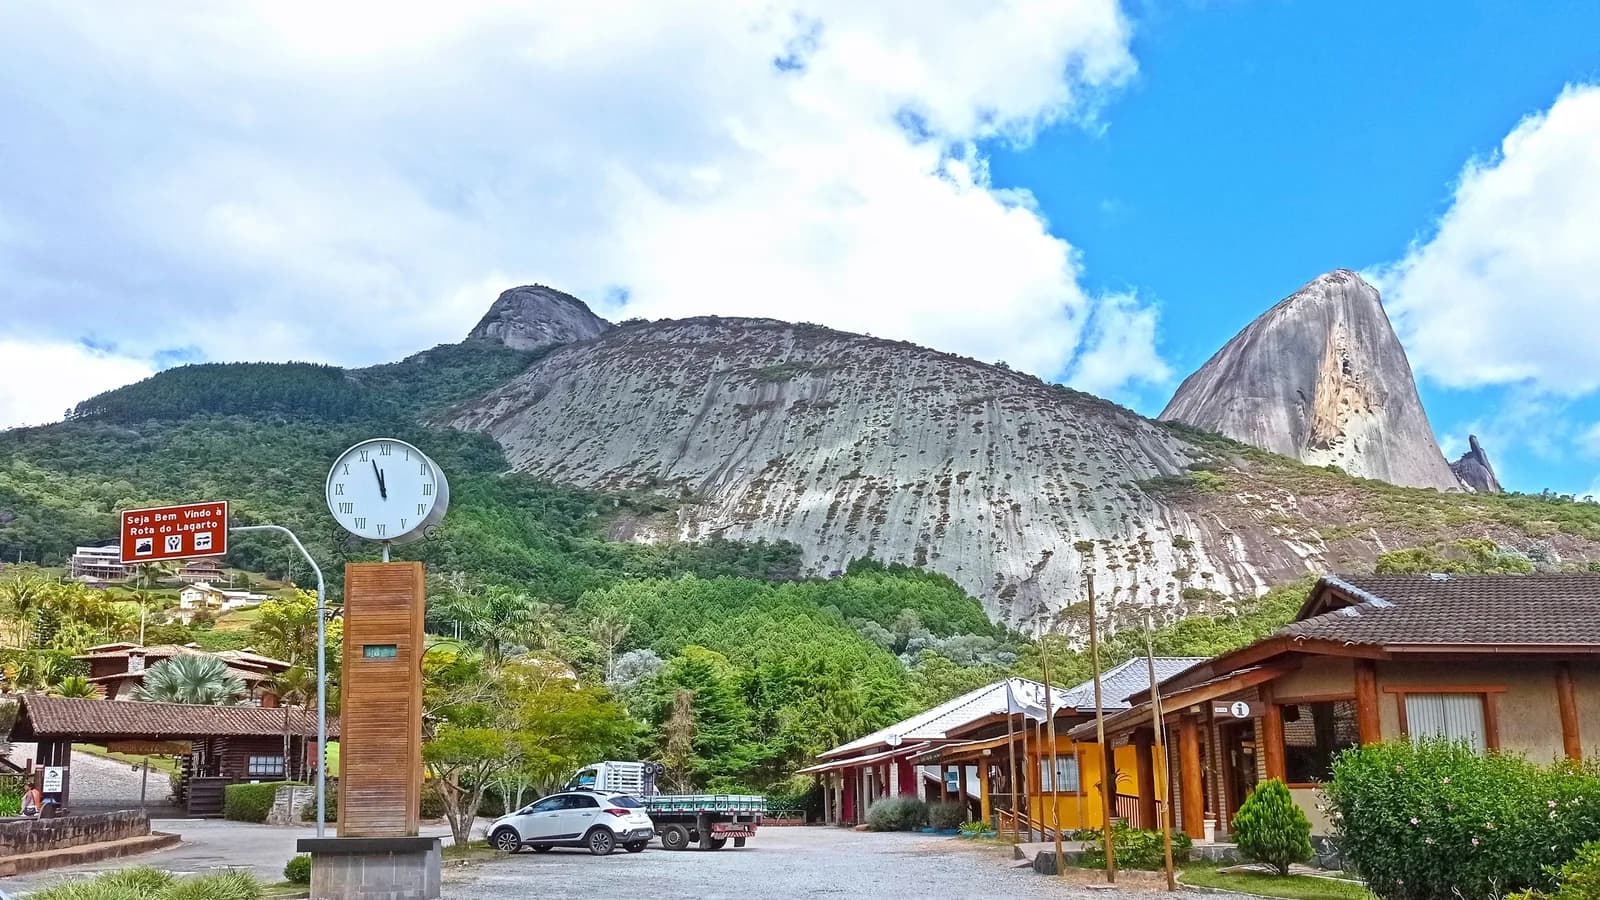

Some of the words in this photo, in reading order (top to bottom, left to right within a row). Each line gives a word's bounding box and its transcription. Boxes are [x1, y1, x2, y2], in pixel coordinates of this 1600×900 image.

[360, 450, 368, 462] XI
[380, 444, 392, 456] XII
[343, 464, 350, 475] X
[420, 464, 426, 475] II
[335, 484, 344, 495] IX
[423, 484, 432, 496] III
[339, 502, 353, 514] VIII
[417, 503, 426, 515] IV
[127, 515, 149, 526] Seja
[155, 513, 177, 522] Bem
[184, 509, 211, 519] Vindo
[215, 506, 222, 516] à
[130, 526, 155, 536] Rota
[159, 525, 172, 533] do
[177, 520, 218, 532] Lagarto
[354, 517, 366, 529] VII
[400, 519, 407, 529] V
[377, 524, 386, 536] VI
